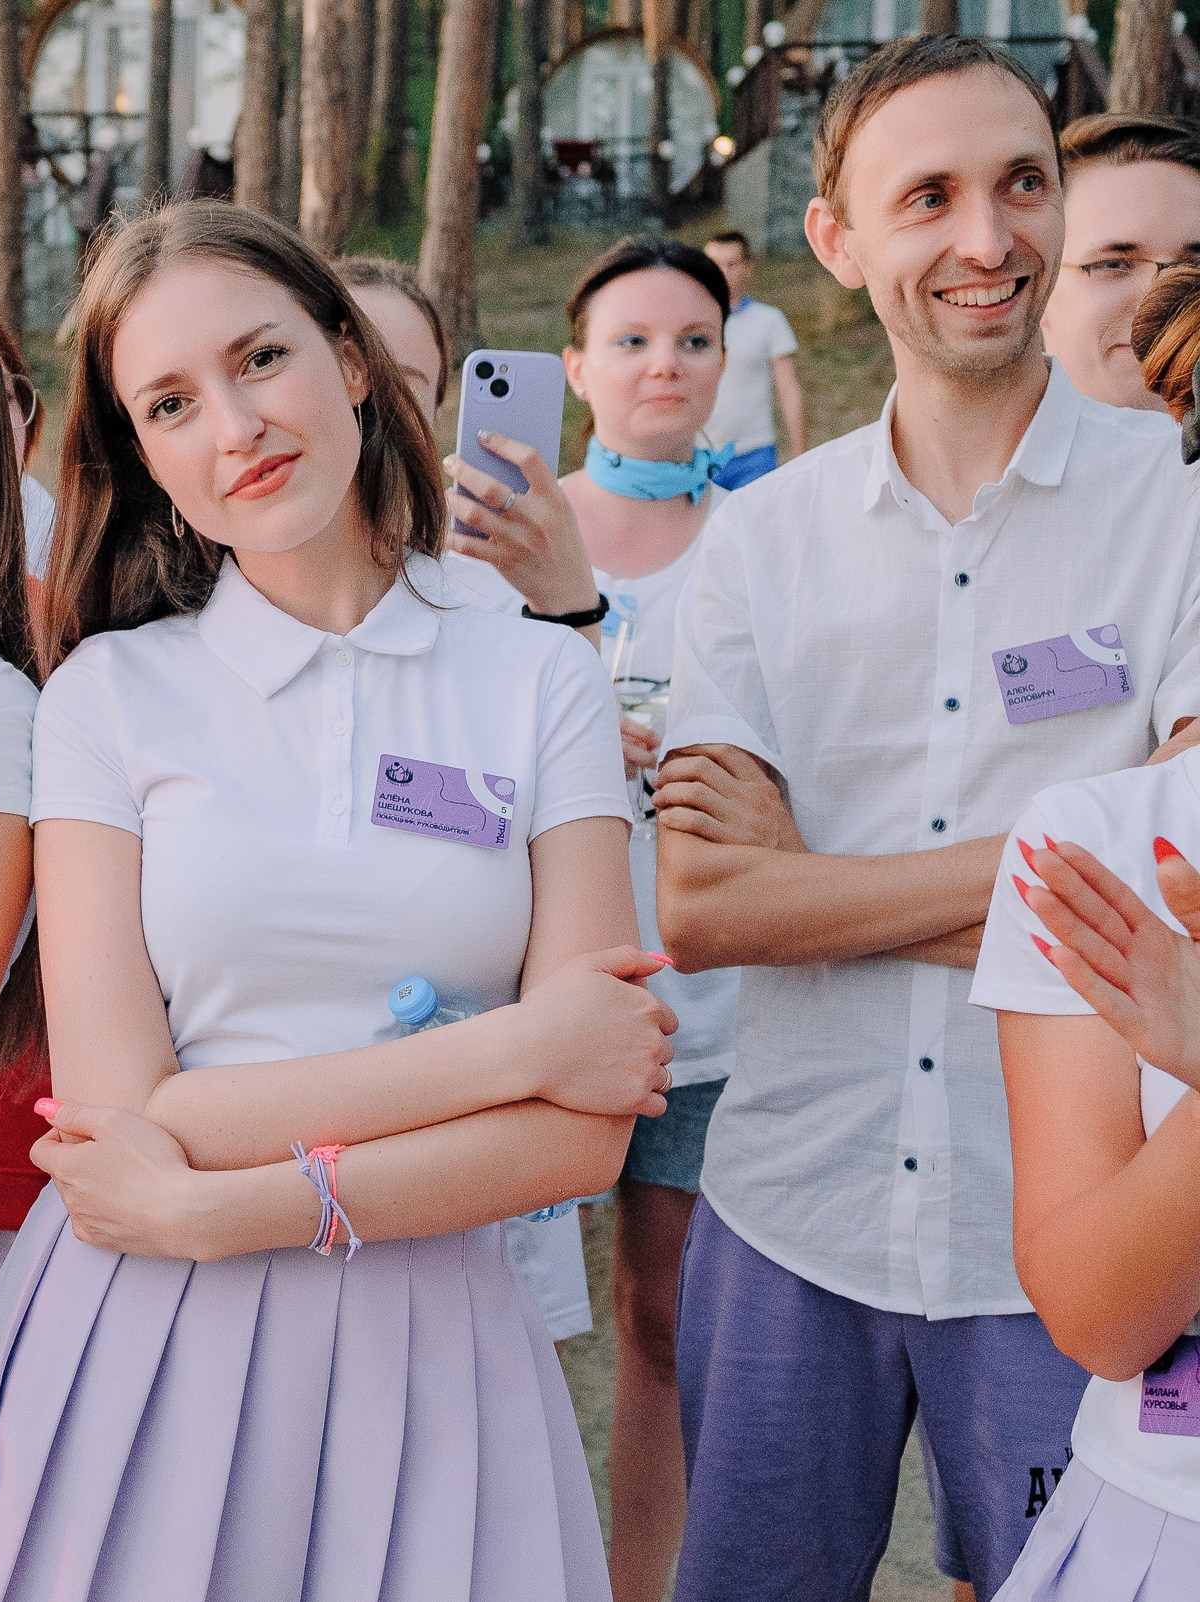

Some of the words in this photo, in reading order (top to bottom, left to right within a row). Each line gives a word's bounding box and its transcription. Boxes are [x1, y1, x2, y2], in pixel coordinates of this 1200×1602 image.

[1114, 653, 1121, 661] 5
[1006, 684, 1035, 697] АЛЕКС
[378, 792, 411, 805] АЛЁНА
[377, 801, 434, 818] ШЕШУКОВА
[501, 806, 507, 814] 5
[495, 817, 507, 844] ОТРЯД
[1144, 1386, 1180, 1398] МИЛАНА
[1143, 1399, 1188, 1411] КУРСОВЫЕ
